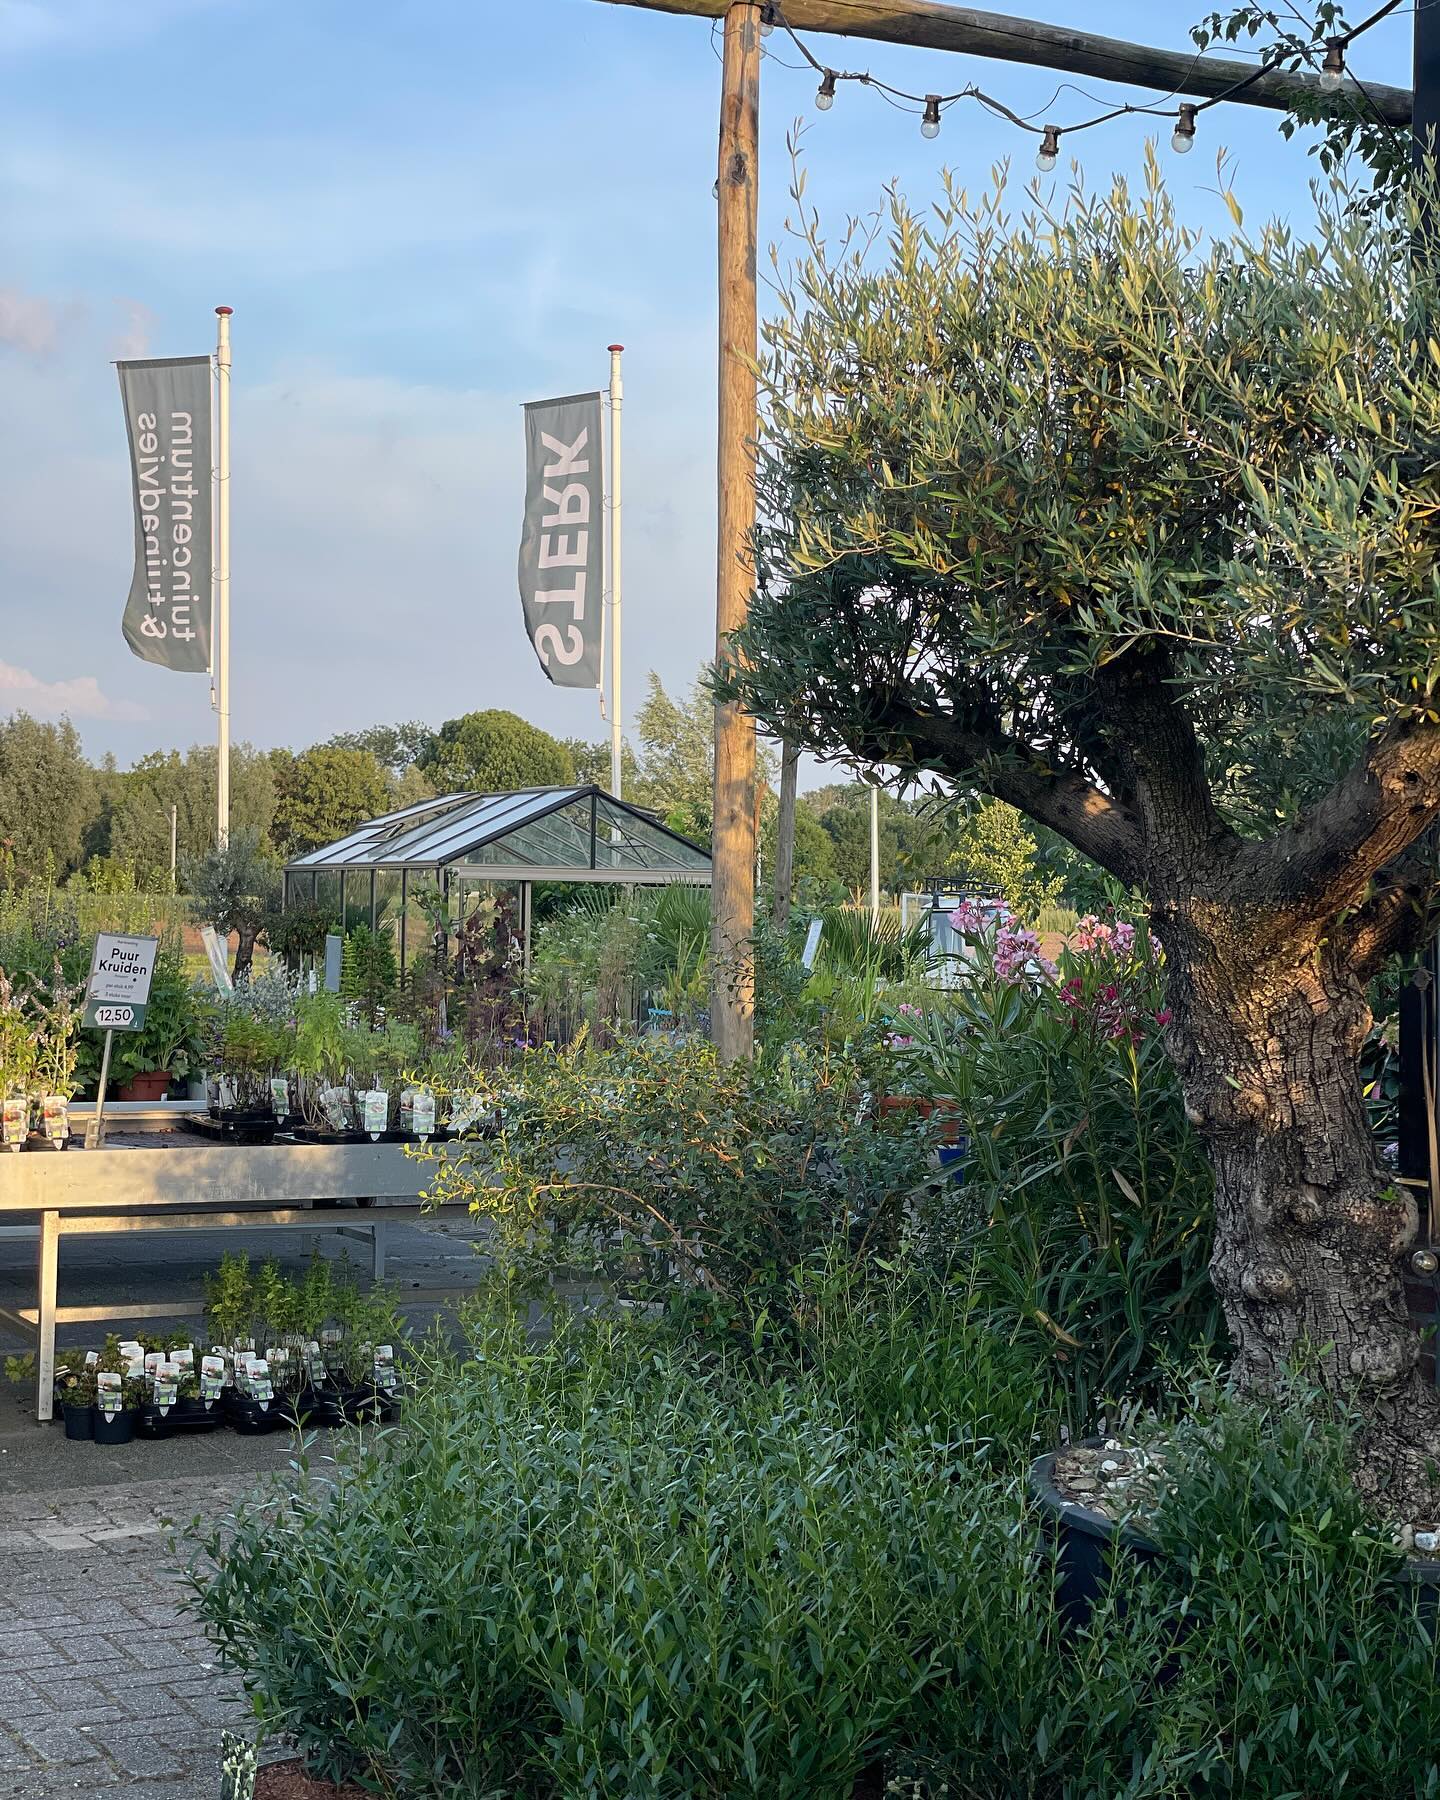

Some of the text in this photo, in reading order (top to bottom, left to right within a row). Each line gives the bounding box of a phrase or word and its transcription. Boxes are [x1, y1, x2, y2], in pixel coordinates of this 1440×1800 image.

[111, 948, 139, 961] Puur
[99, 960, 147, 975] Kruiden
[99, 1009, 131, 1022] 12,50
